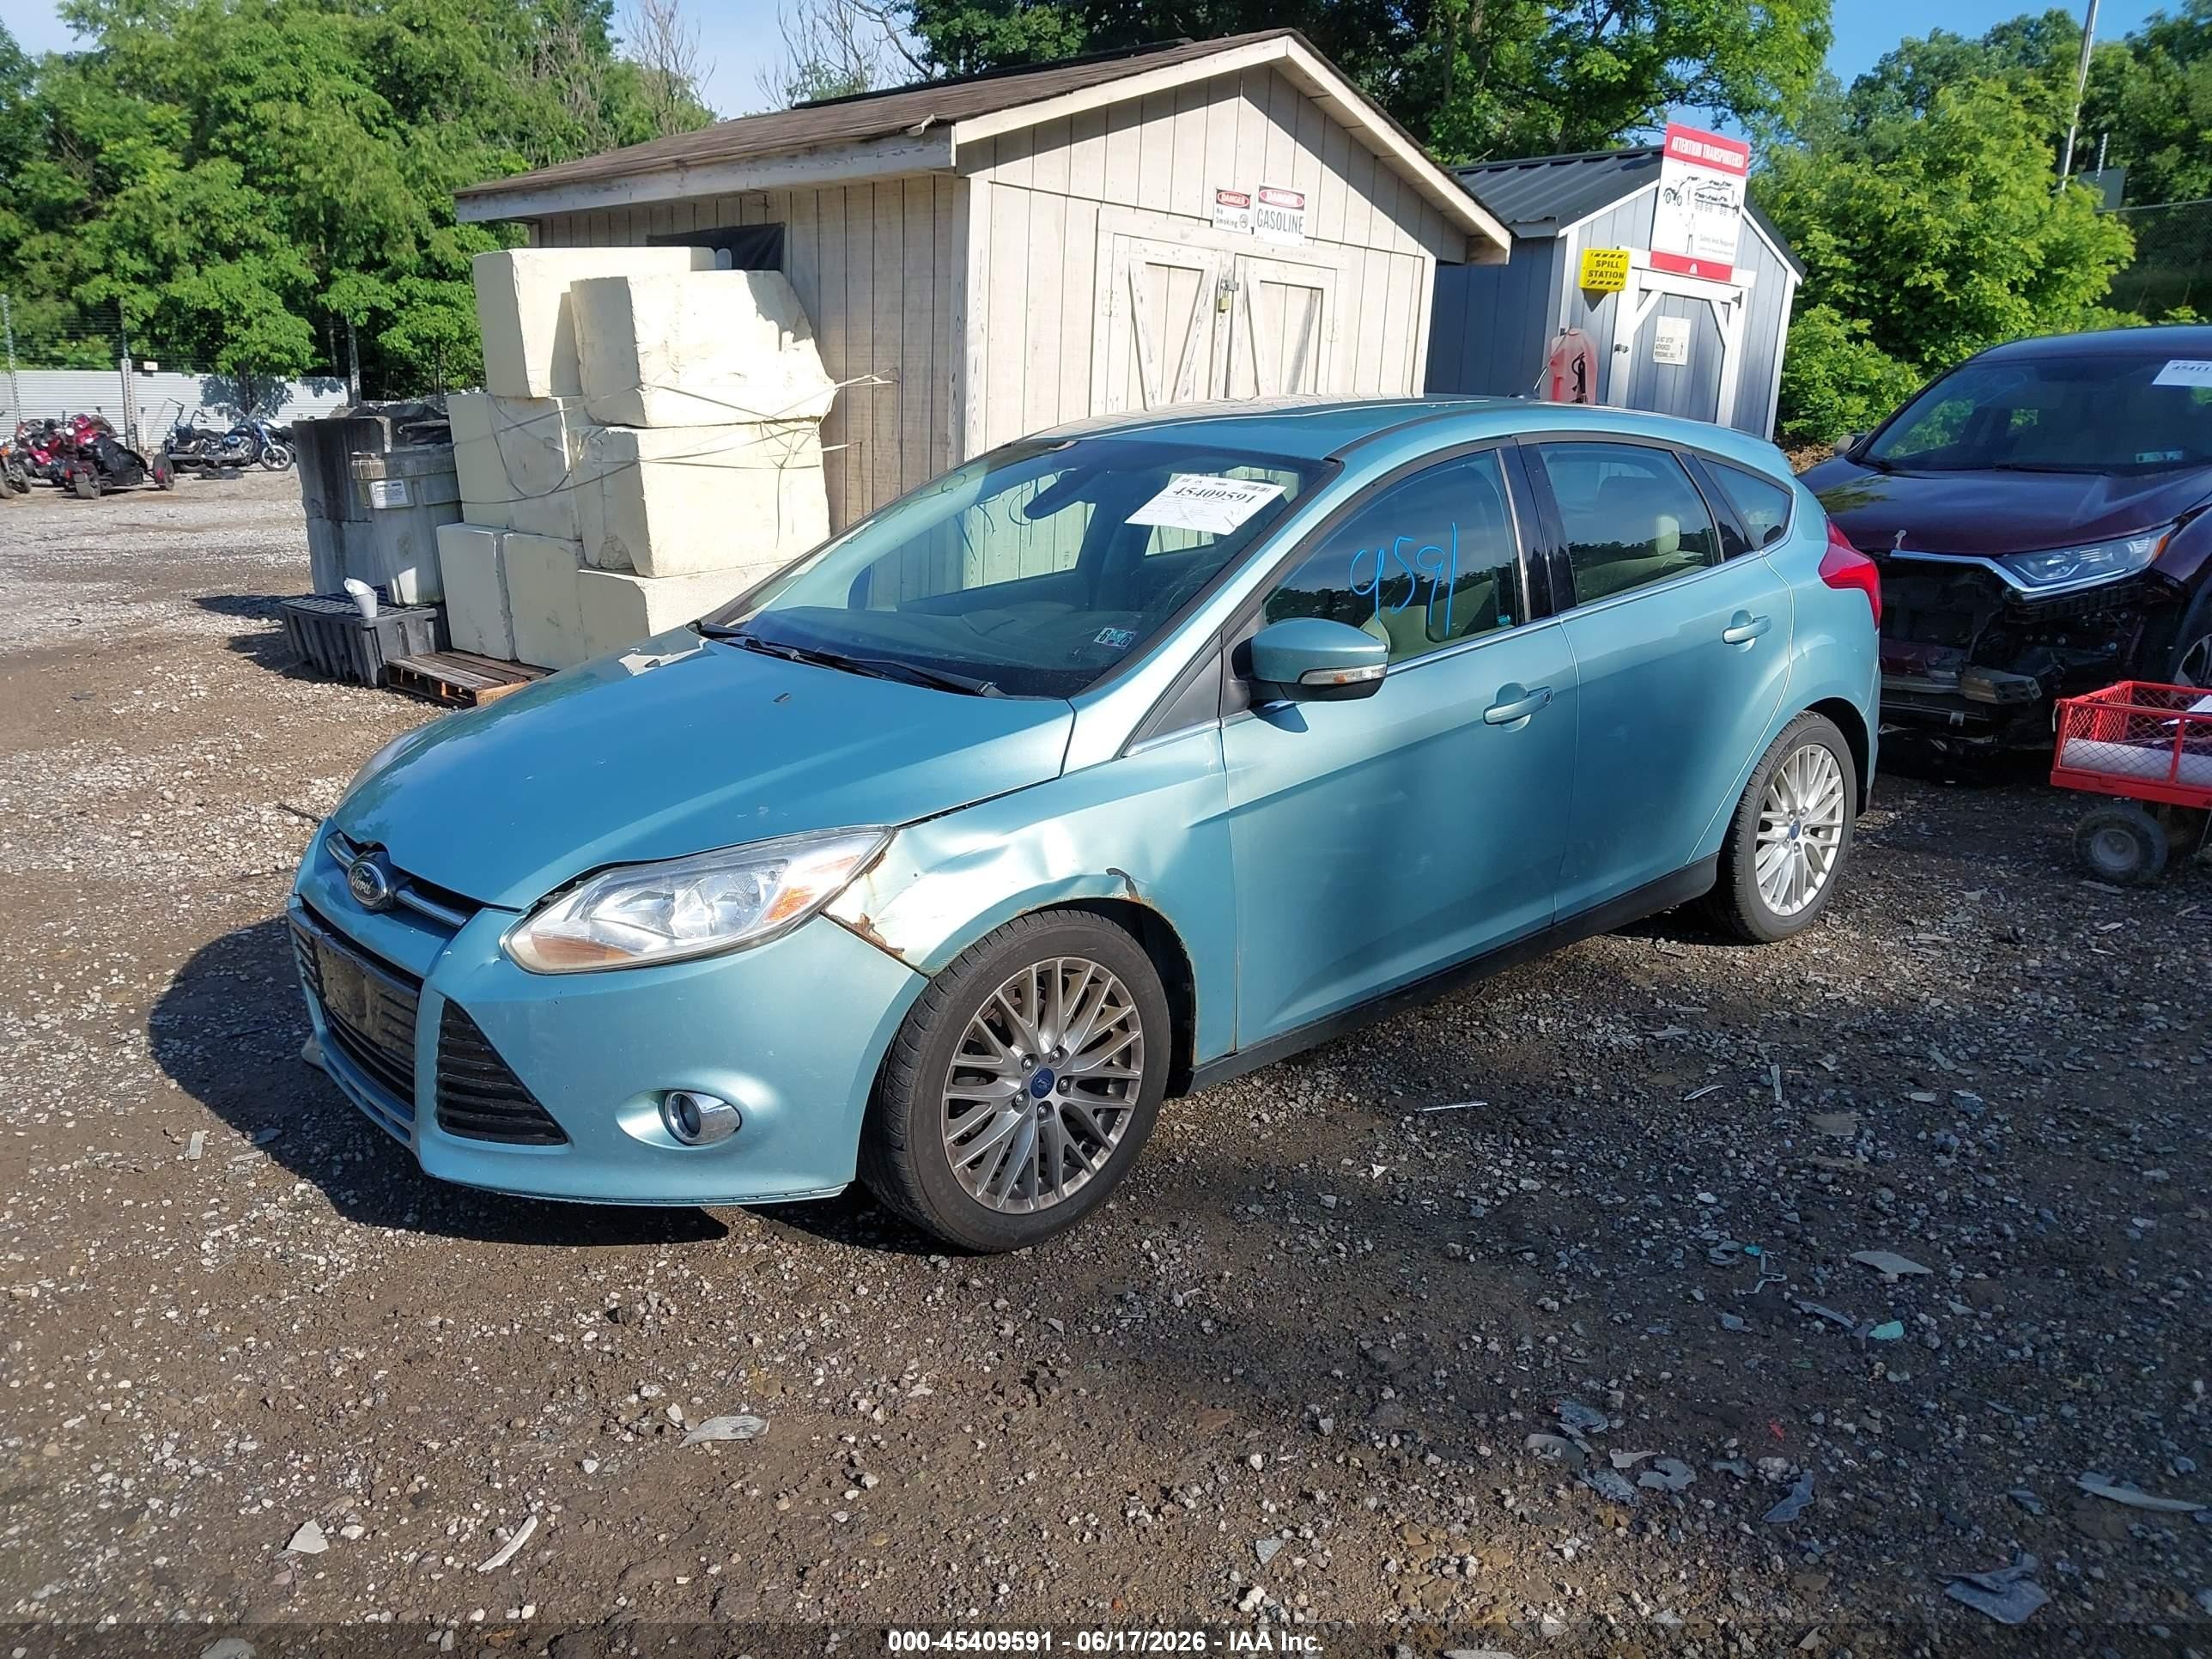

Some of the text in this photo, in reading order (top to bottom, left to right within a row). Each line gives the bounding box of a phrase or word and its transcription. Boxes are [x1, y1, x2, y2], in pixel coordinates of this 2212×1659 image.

[1256, 208, 1304, 234] GASOLINE
[1595, 259, 1620, 269] SPILL
[1588, 270, 1625, 279] STATION
[1173, 486, 1257, 503] 45409591
[351, 867, 374, 895] Ford
